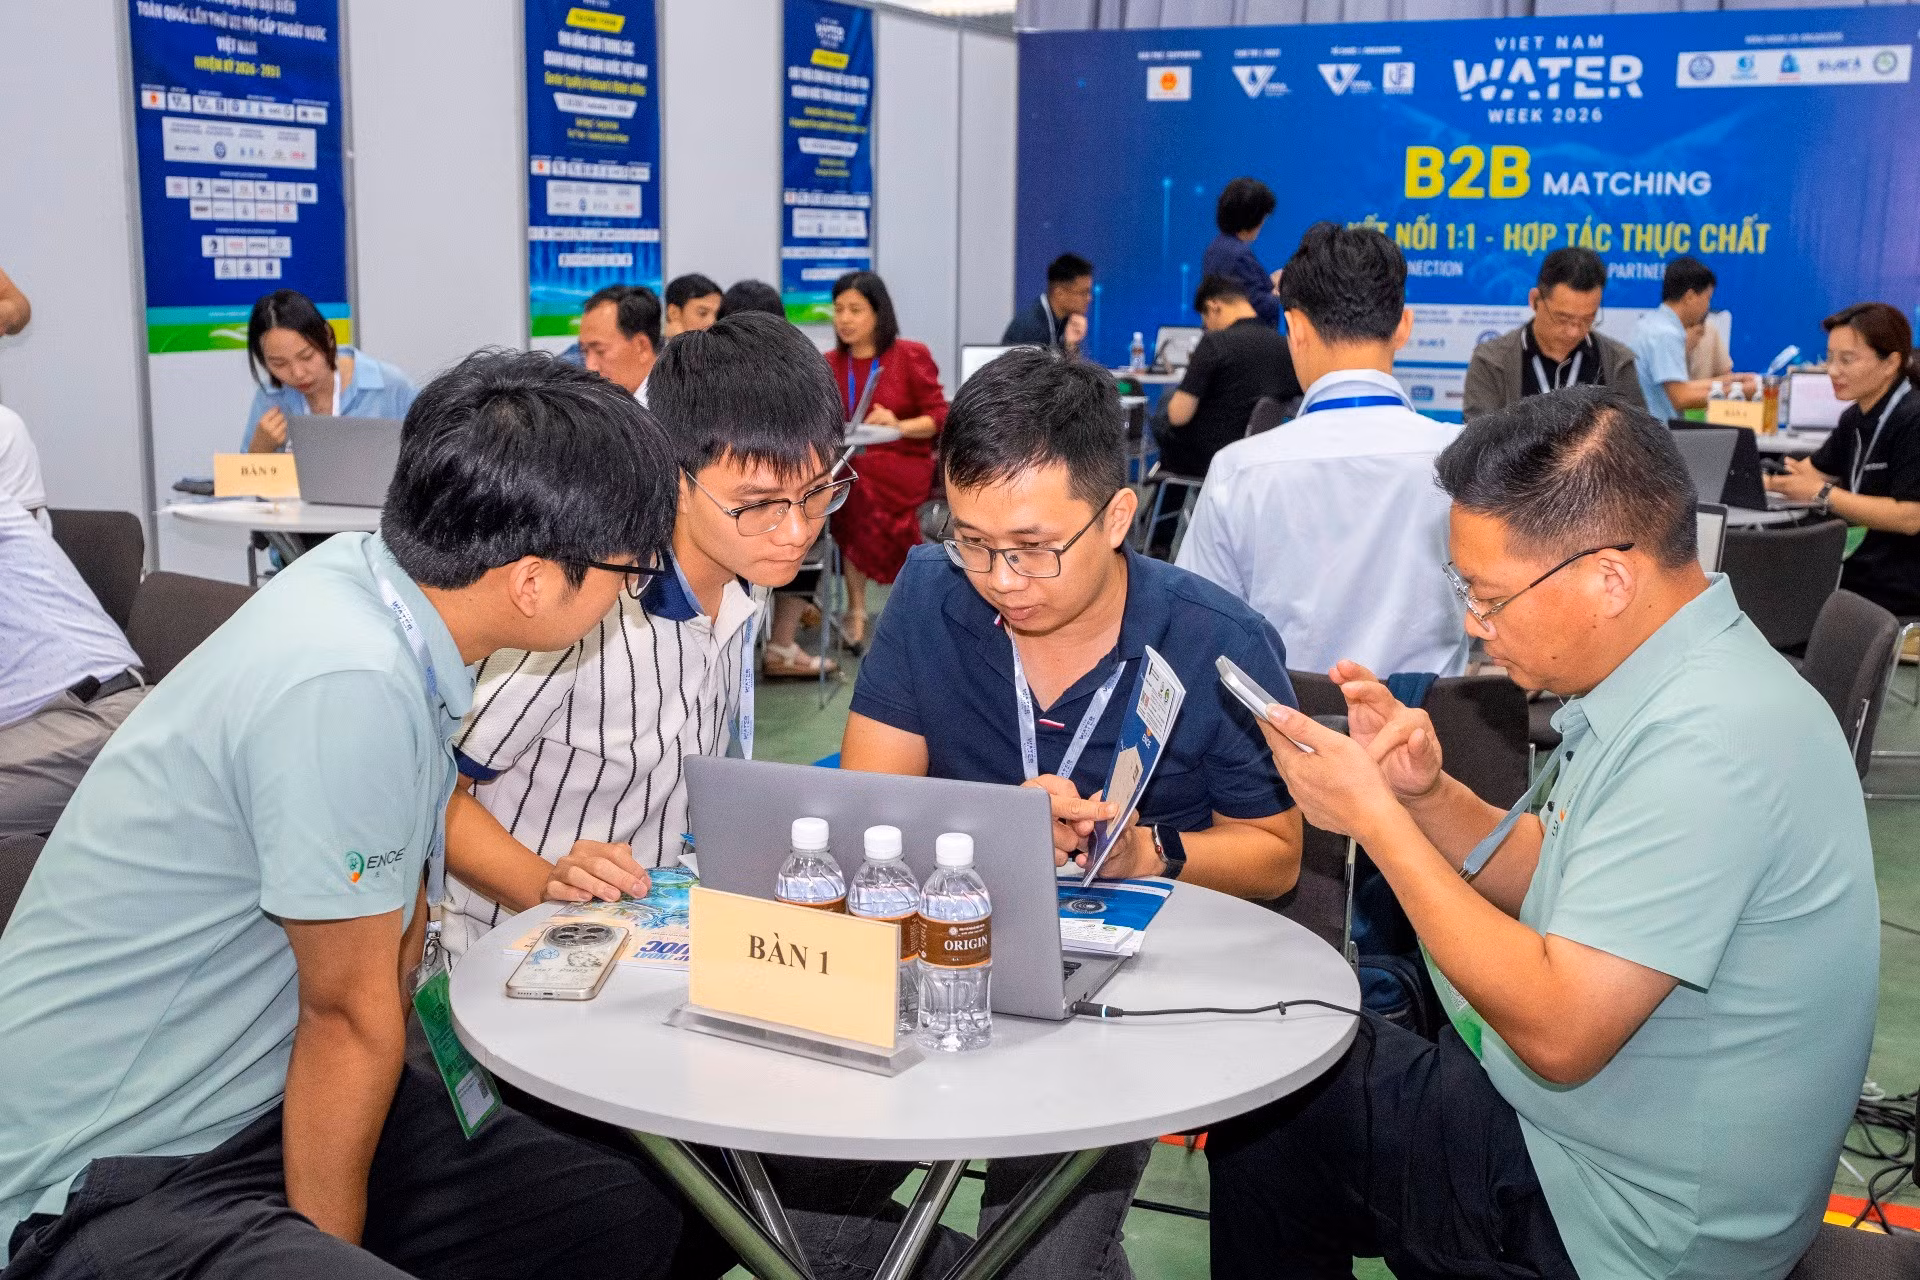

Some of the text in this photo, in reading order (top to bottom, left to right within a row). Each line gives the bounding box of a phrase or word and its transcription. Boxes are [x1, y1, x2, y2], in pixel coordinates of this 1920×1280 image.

[1494, 34, 1604, 51] VIET NAM
[1453, 54, 1644, 101] WATER
[1487, 106, 1603, 124] WEEK 2026
[1404, 144, 1712, 199] B2B MATCHING
[1446, 222, 1475, 250] 1:1
[1503, 221, 1558, 257] HỢP
[1566, 215, 1612, 252] TÁC
[1621, 222, 1692, 258] THỰC
[1700, 212, 1771, 254] CHẤT
[1406, 259, 1463, 277] NECTION
[241, 464, 267, 476] BÀN
[367, 847, 405, 869] ENCE
[944, 934, 988, 951] ORIGIN
[747, 931, 830, 976] BÀN 1
